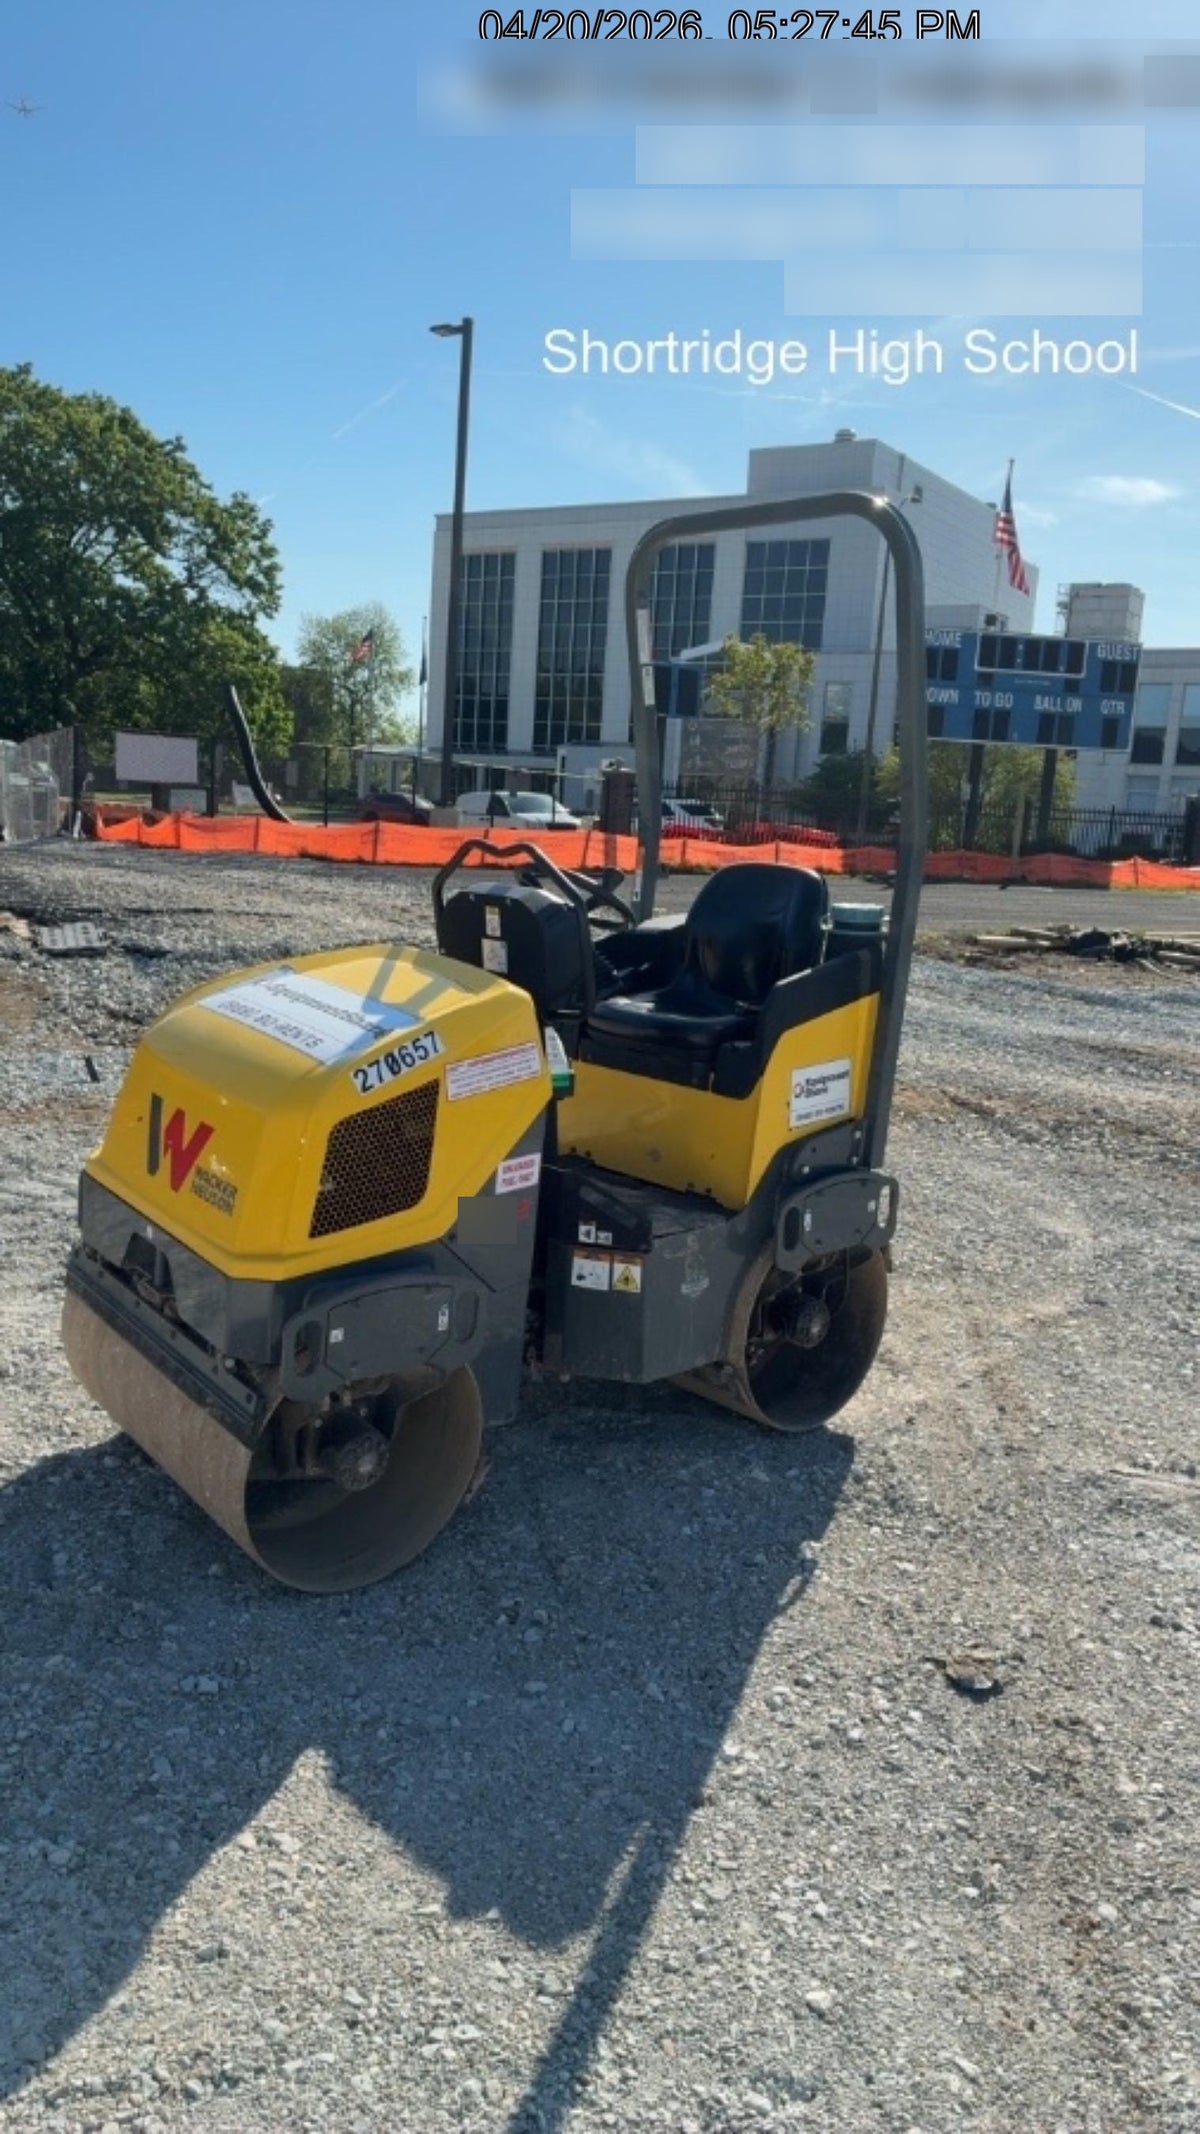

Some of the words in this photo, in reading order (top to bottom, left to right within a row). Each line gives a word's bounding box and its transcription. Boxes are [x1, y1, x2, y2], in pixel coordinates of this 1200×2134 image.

[924, 630, 962, 648] HOME
[1097, 644, 1140, 660] GUEST
[926, 687, 960, 704] OWN
[974, 690, 993, 707] TO
[1033, 694, 1063, 712] BALL
[1100, 698, 1125, 714] QTR
[353, 1031, 440, 1093] 270657
